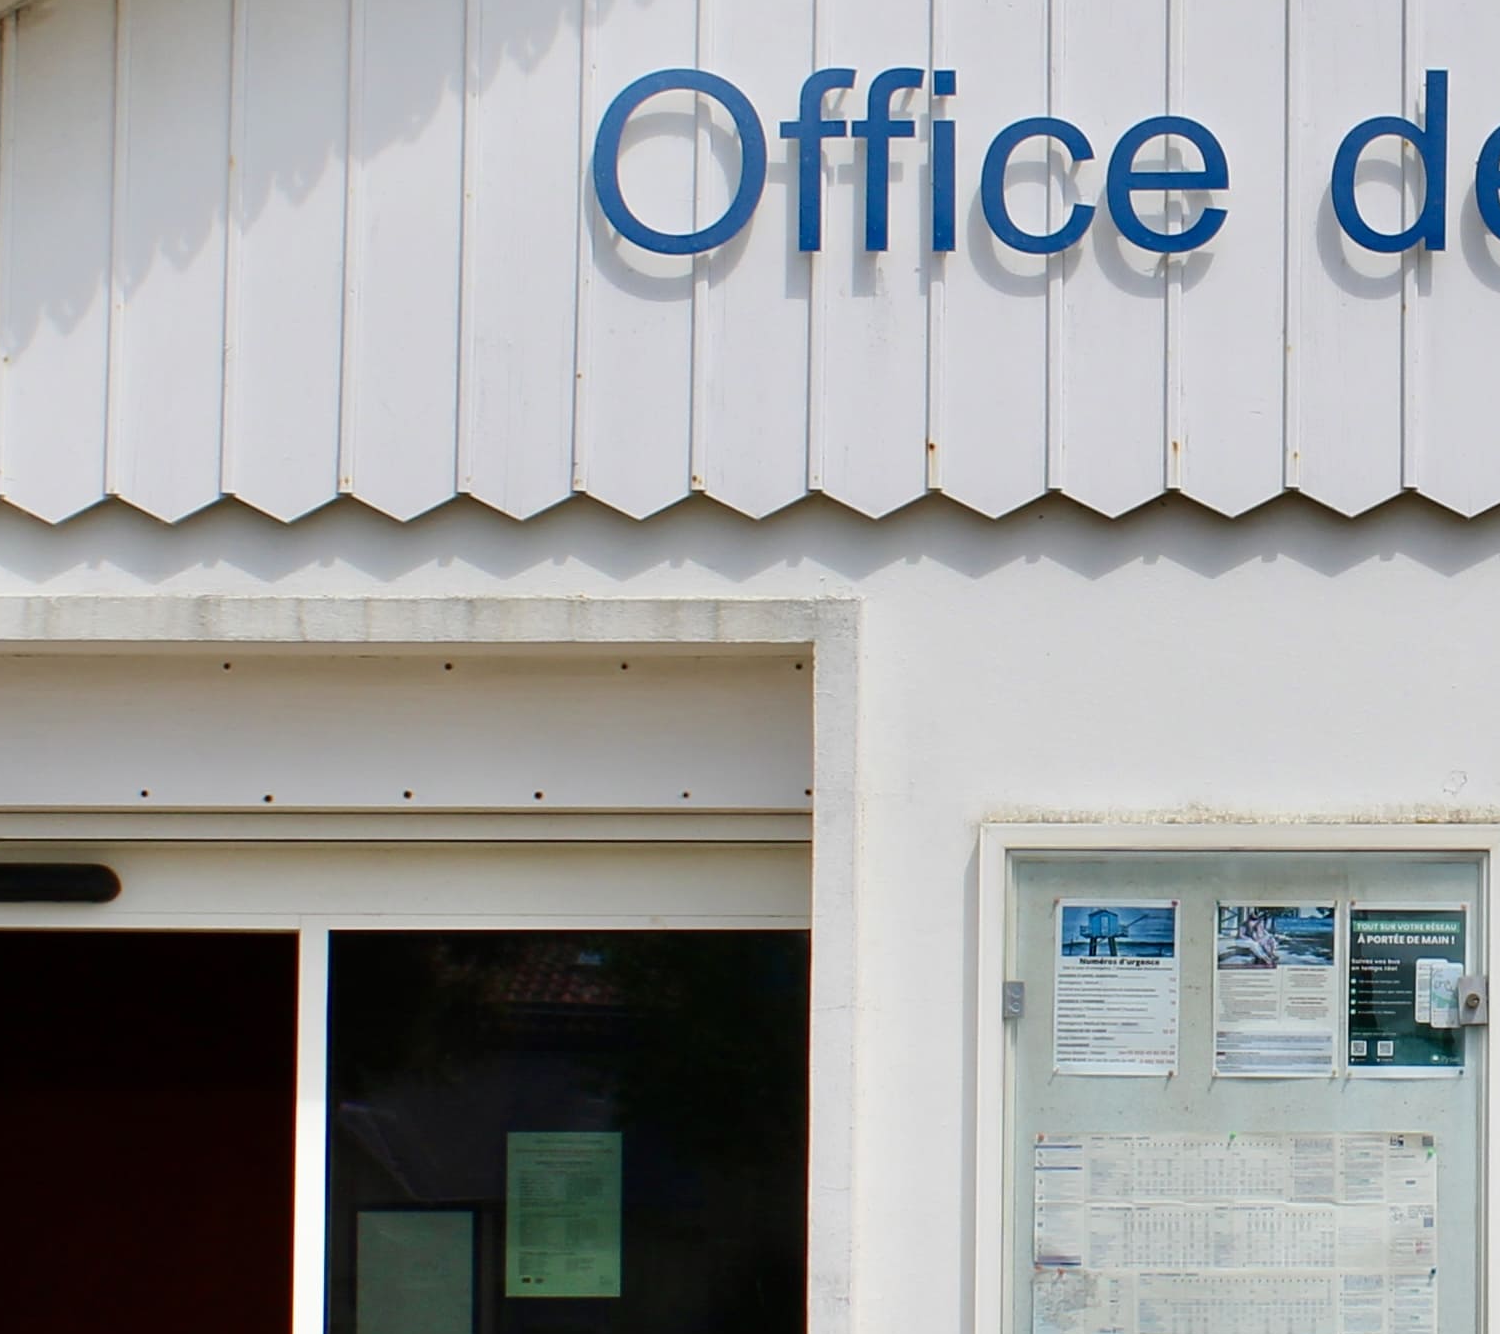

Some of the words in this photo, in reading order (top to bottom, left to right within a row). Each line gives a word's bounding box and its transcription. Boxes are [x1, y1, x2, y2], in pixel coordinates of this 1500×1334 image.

[590, 67, 1229, 255] Office
[1398, 923, 1424, 931] VOTRE
[1426, 923, 1457, 931] RÉSEAU
[1358, 933, 1365, 944] À
[1367, 934, 1404, 944] PORTÉE
[1407, 935, 1419, 944] DE
[1422, 935, 1449, 944] MAIN
